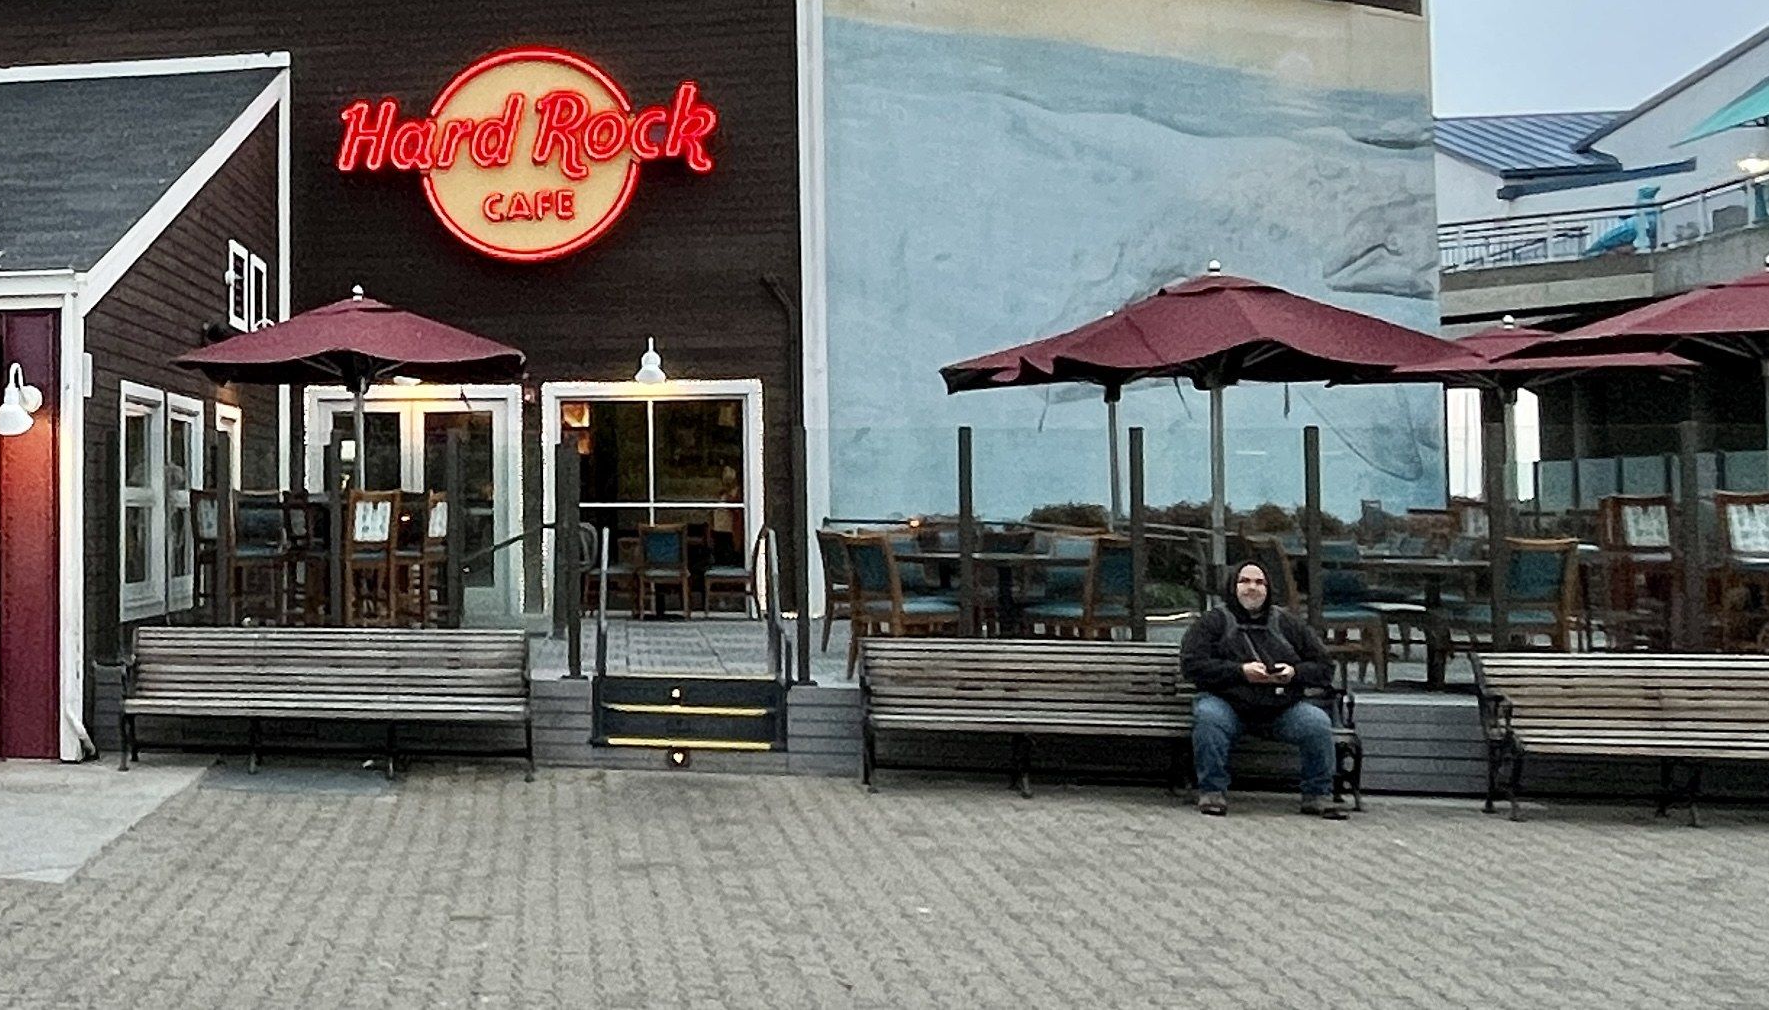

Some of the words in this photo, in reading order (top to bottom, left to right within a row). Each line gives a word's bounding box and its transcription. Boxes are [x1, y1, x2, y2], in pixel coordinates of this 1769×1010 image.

[336, 92, 526, 172] Hard
[531, 80, 718, 180] Rock
[482, 190, 576, 222] CAFE
